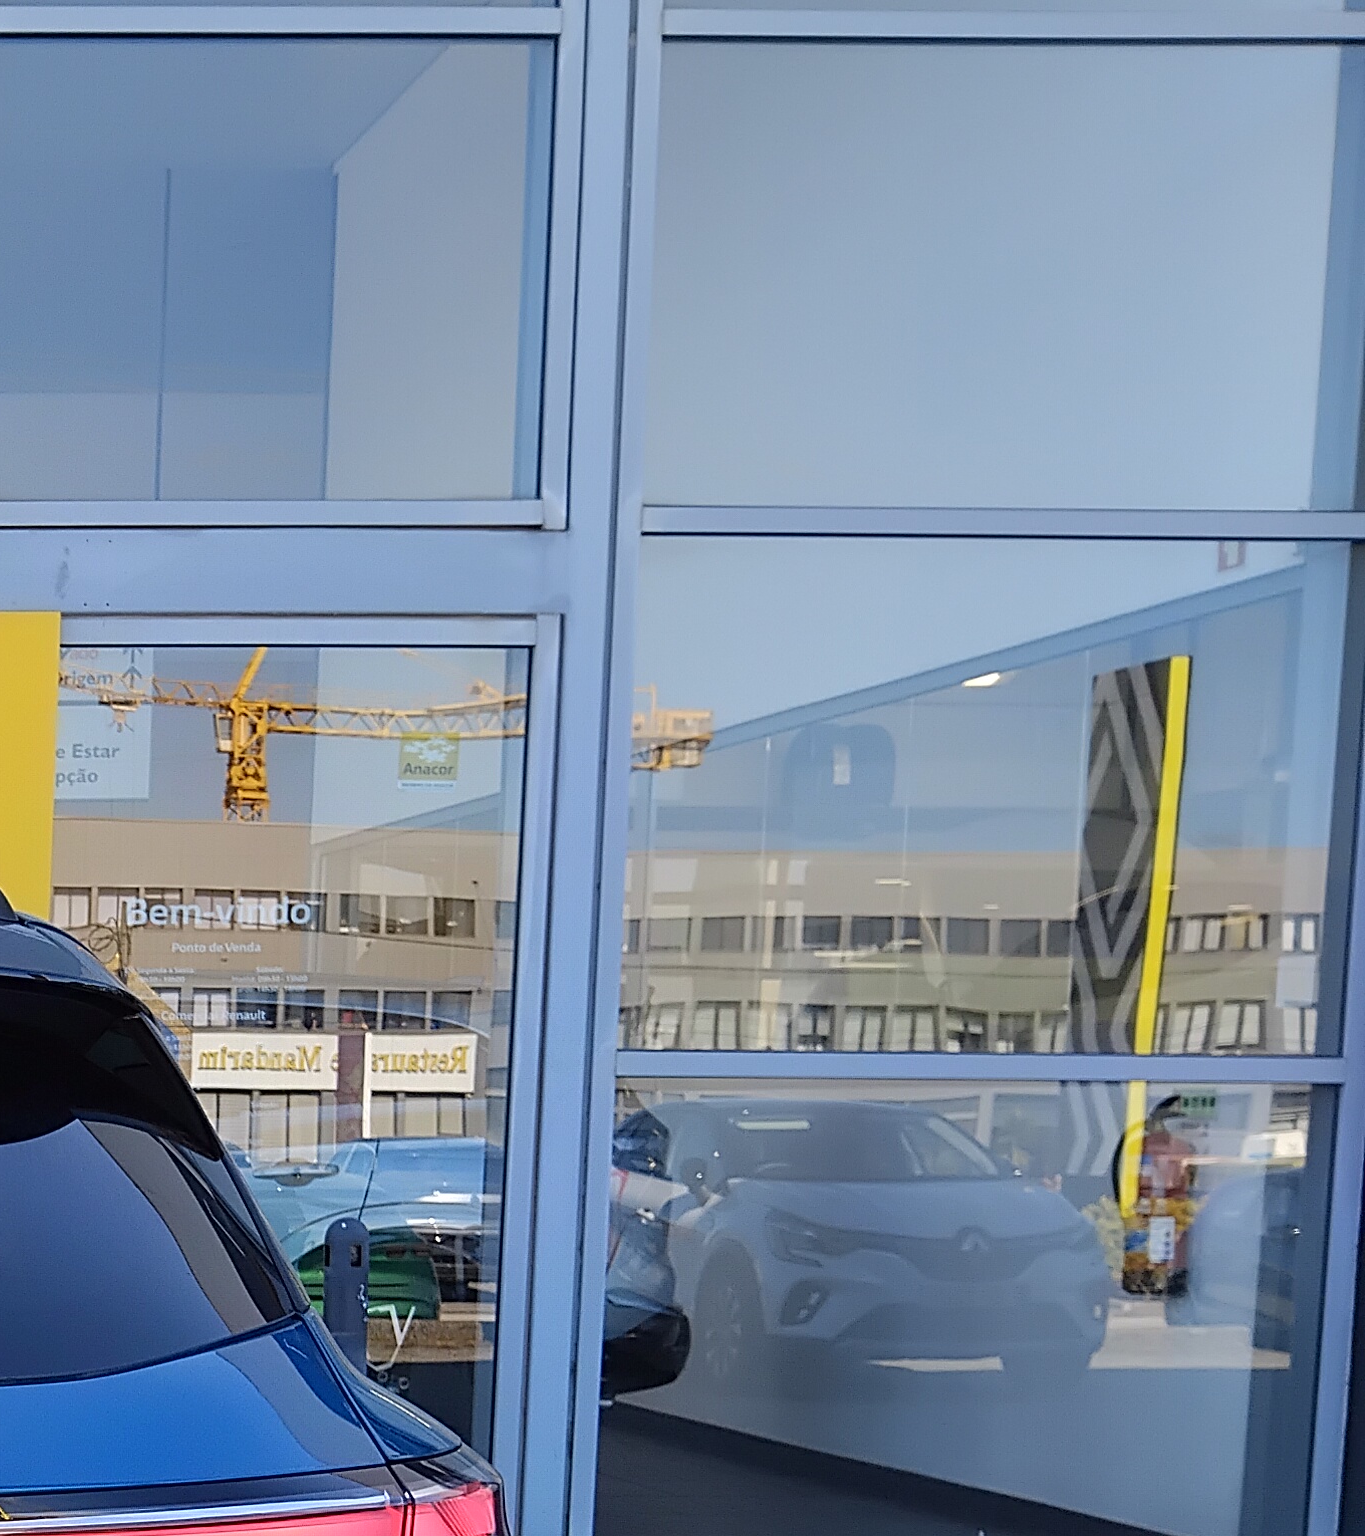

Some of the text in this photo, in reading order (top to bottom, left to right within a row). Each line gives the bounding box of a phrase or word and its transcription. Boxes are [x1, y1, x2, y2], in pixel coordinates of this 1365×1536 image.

[72, 743, 120, 759] Estar
[403, 762, 455, 776] Anacor
[126, 895, 312, 927] Bem-vindo
[171, 942, 262, 954] Ponto de Venda
